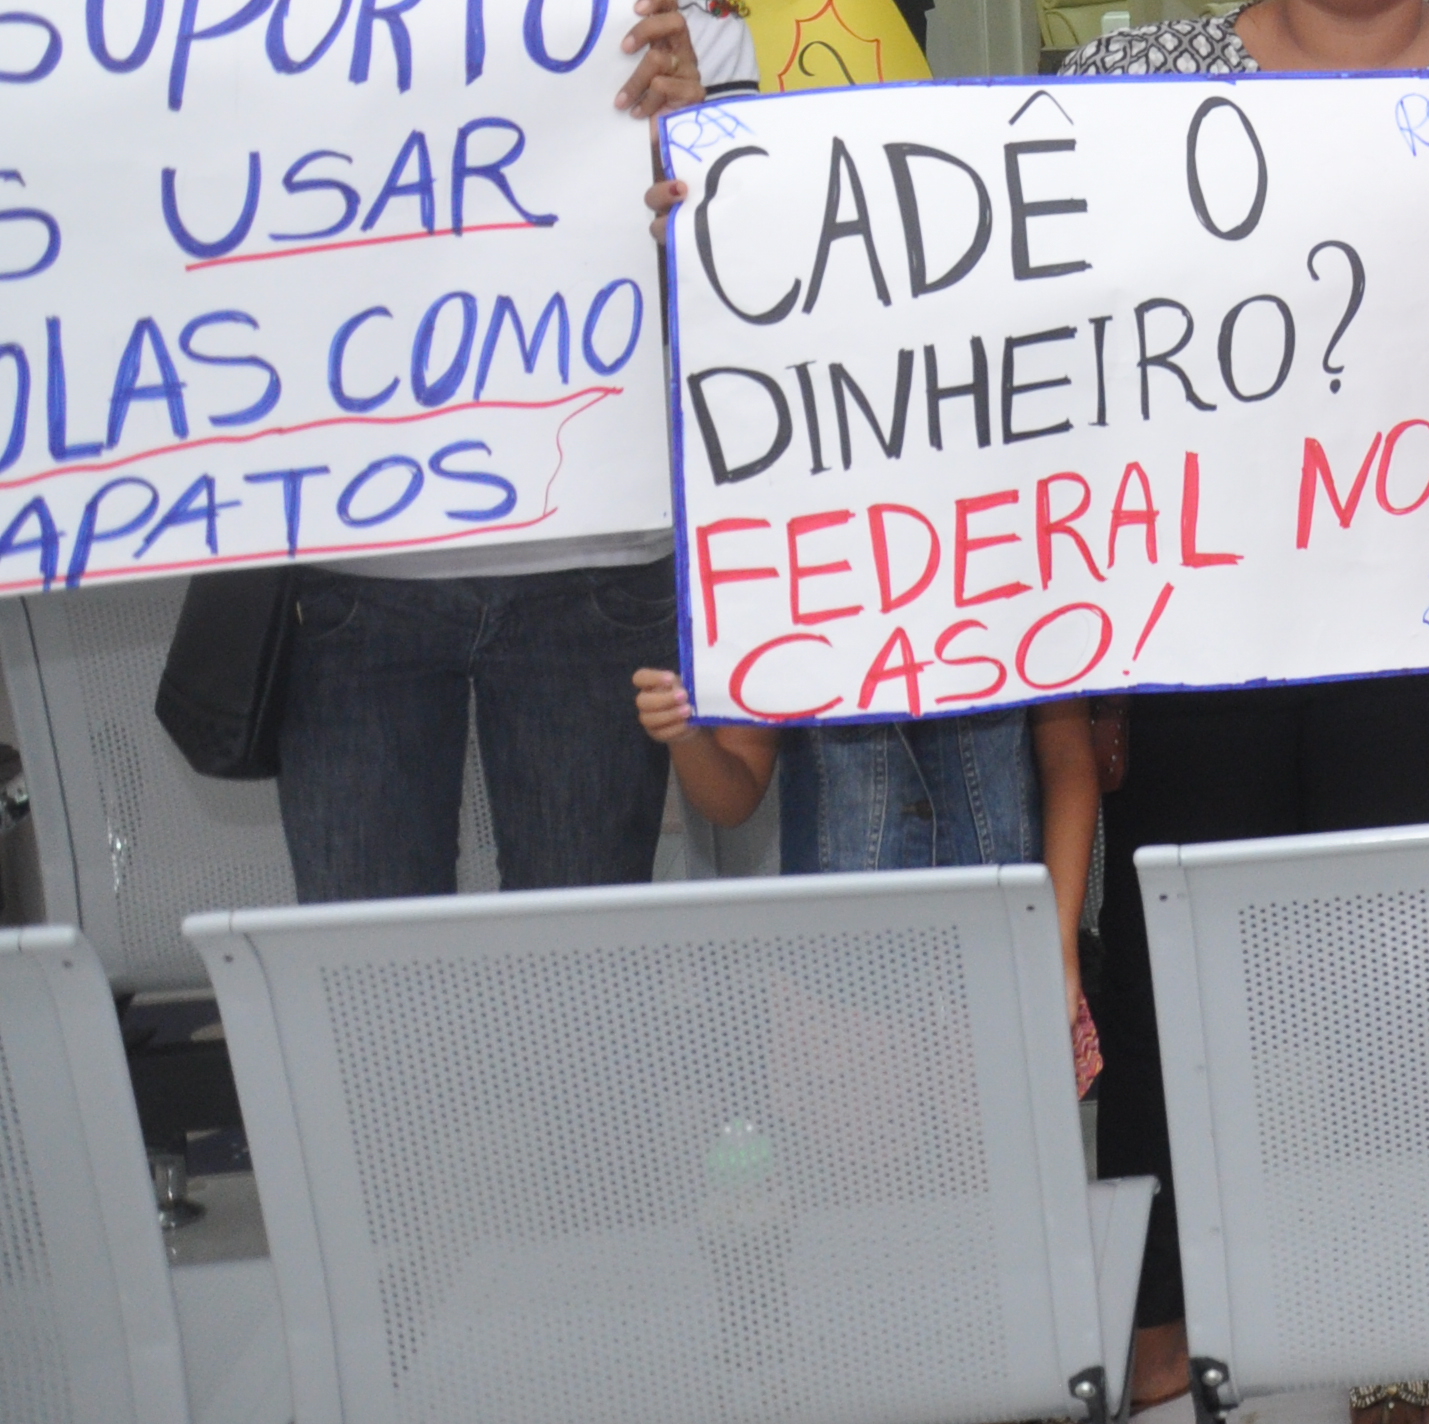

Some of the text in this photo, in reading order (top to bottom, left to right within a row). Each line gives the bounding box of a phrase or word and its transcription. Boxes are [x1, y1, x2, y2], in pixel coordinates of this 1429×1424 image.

[161, 117, 558, 258] USAR
[695, 89, 1268, 326] CADÊ O
[328, 278, 643, 412] COMO
[688, 240, 1365, 485] DINHEIRO?
[696, 451, 1244, 647] FEDERAL
[728, 582, 1174, 719] CASO!
